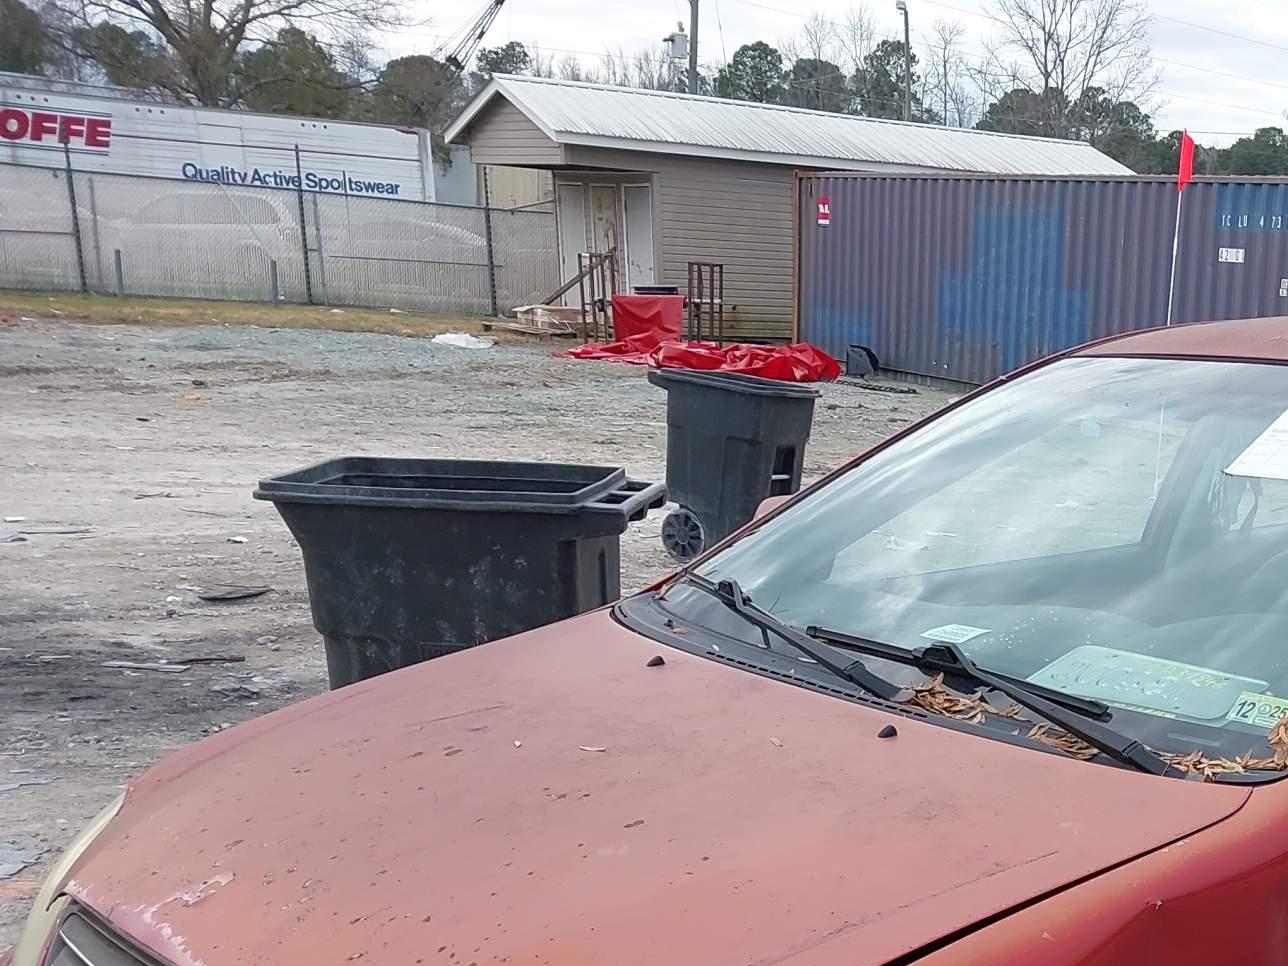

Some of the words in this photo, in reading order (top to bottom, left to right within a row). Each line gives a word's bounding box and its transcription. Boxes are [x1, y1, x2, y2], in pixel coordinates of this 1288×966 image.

[181, 163, 248, 184] Quality
[250, 168, 301, 187] Active
[1235, 700, 1257, 718] 12
